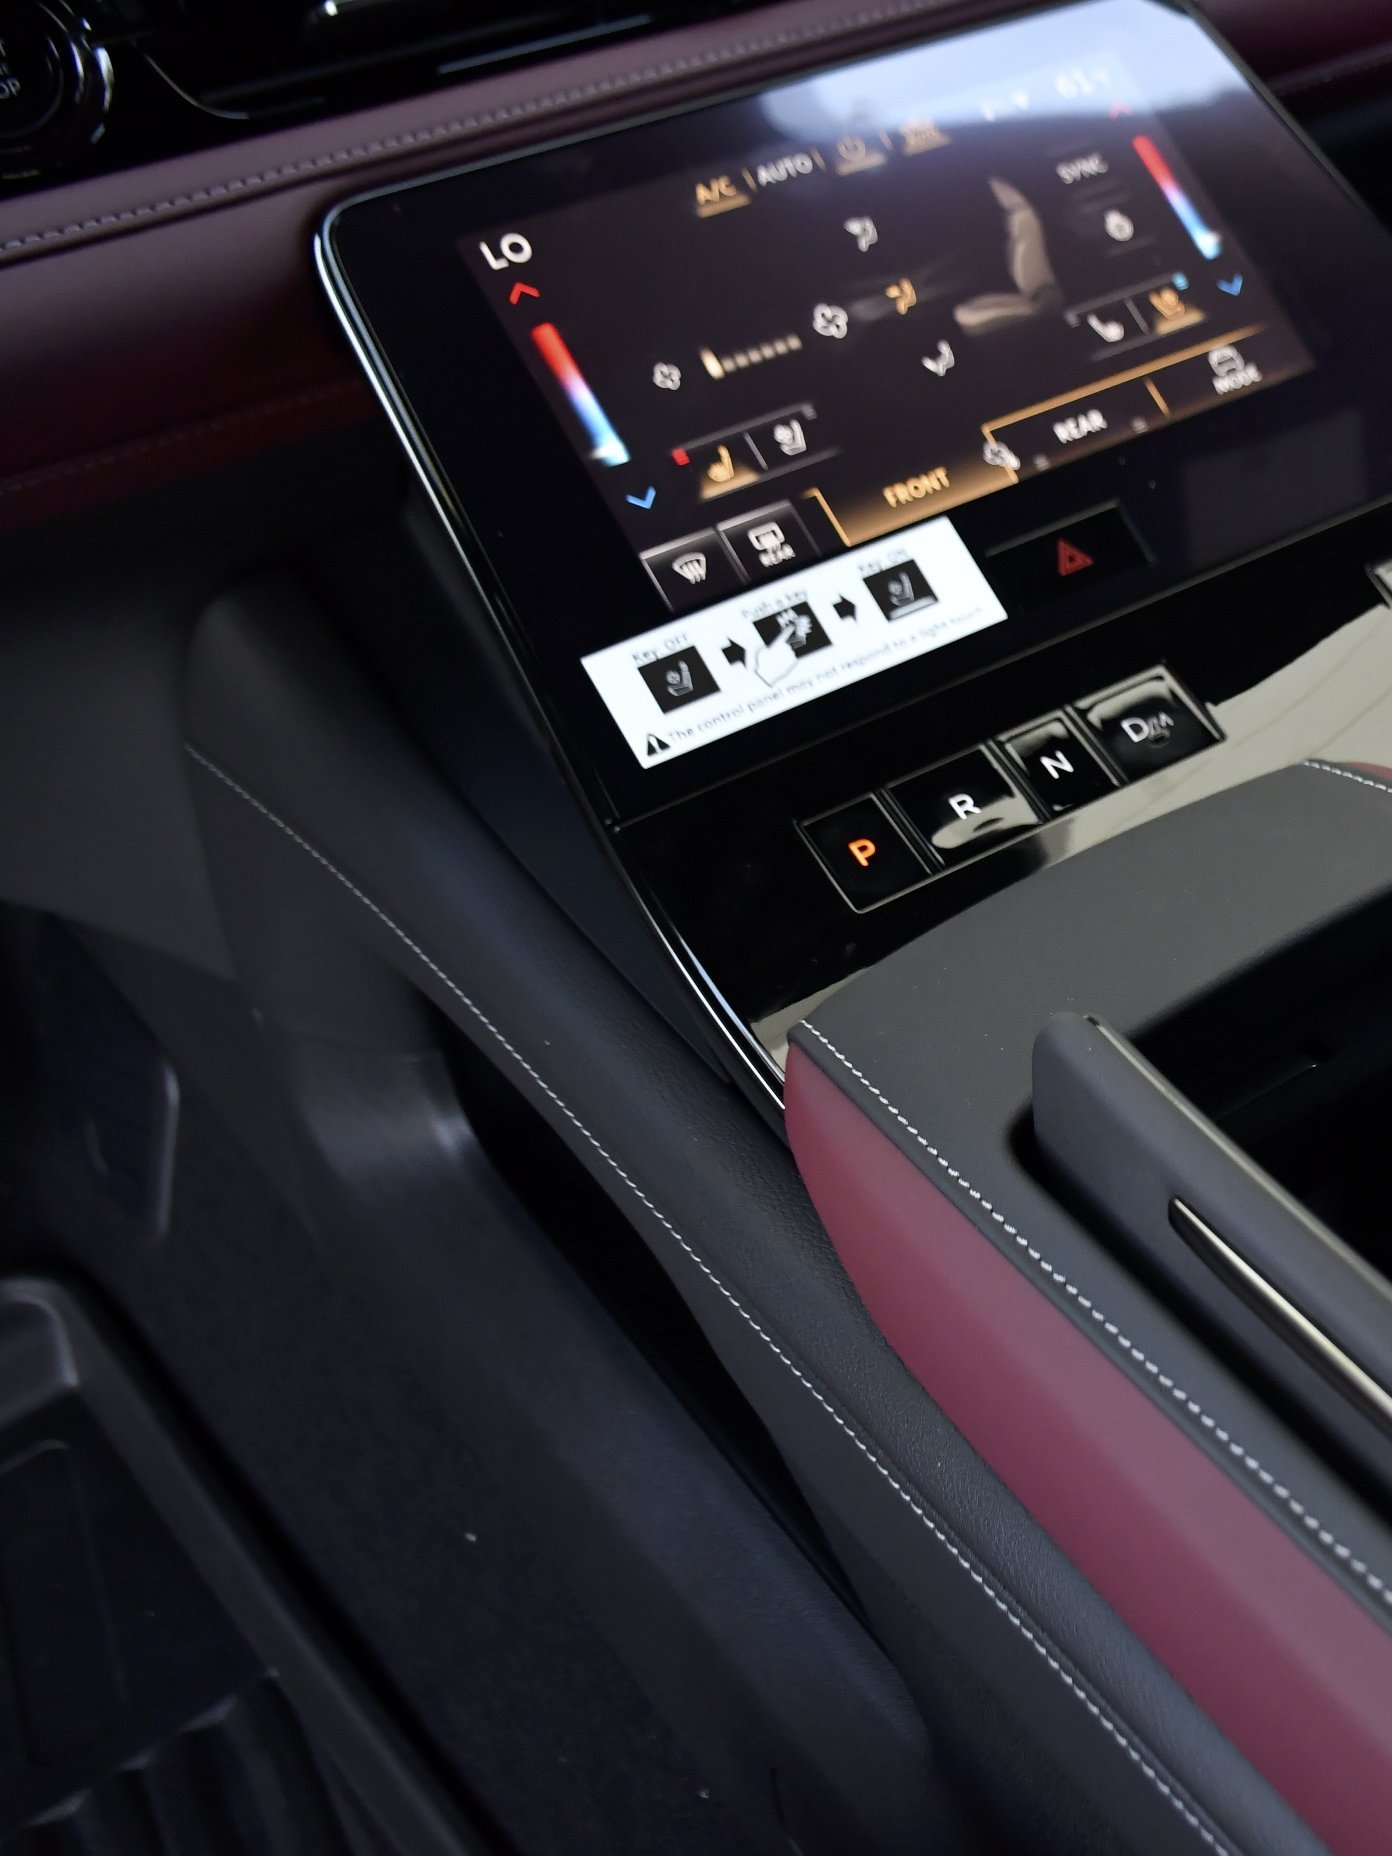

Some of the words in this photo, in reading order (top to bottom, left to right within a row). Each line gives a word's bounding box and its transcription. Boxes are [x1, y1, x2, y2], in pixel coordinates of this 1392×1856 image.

[757, 152, 814, 187] AUTO
[695, 175, 738, 205] A/C
[479, 232, 533, 271] LO
[1053, 409, 1108, 444] REAR
[882, 465, 949, 508] FRONT
[668, 726, 694, 742] The
[697, 704, 745, 730] control
[747, 688, 784, 713] panel
[786, 679, 814, 696] may
[840, 643, 892, 671] respond
[1039, 749, 1074, 780] N
[948, 793, 981, 820] R
[847, 837, 877, 868] P
